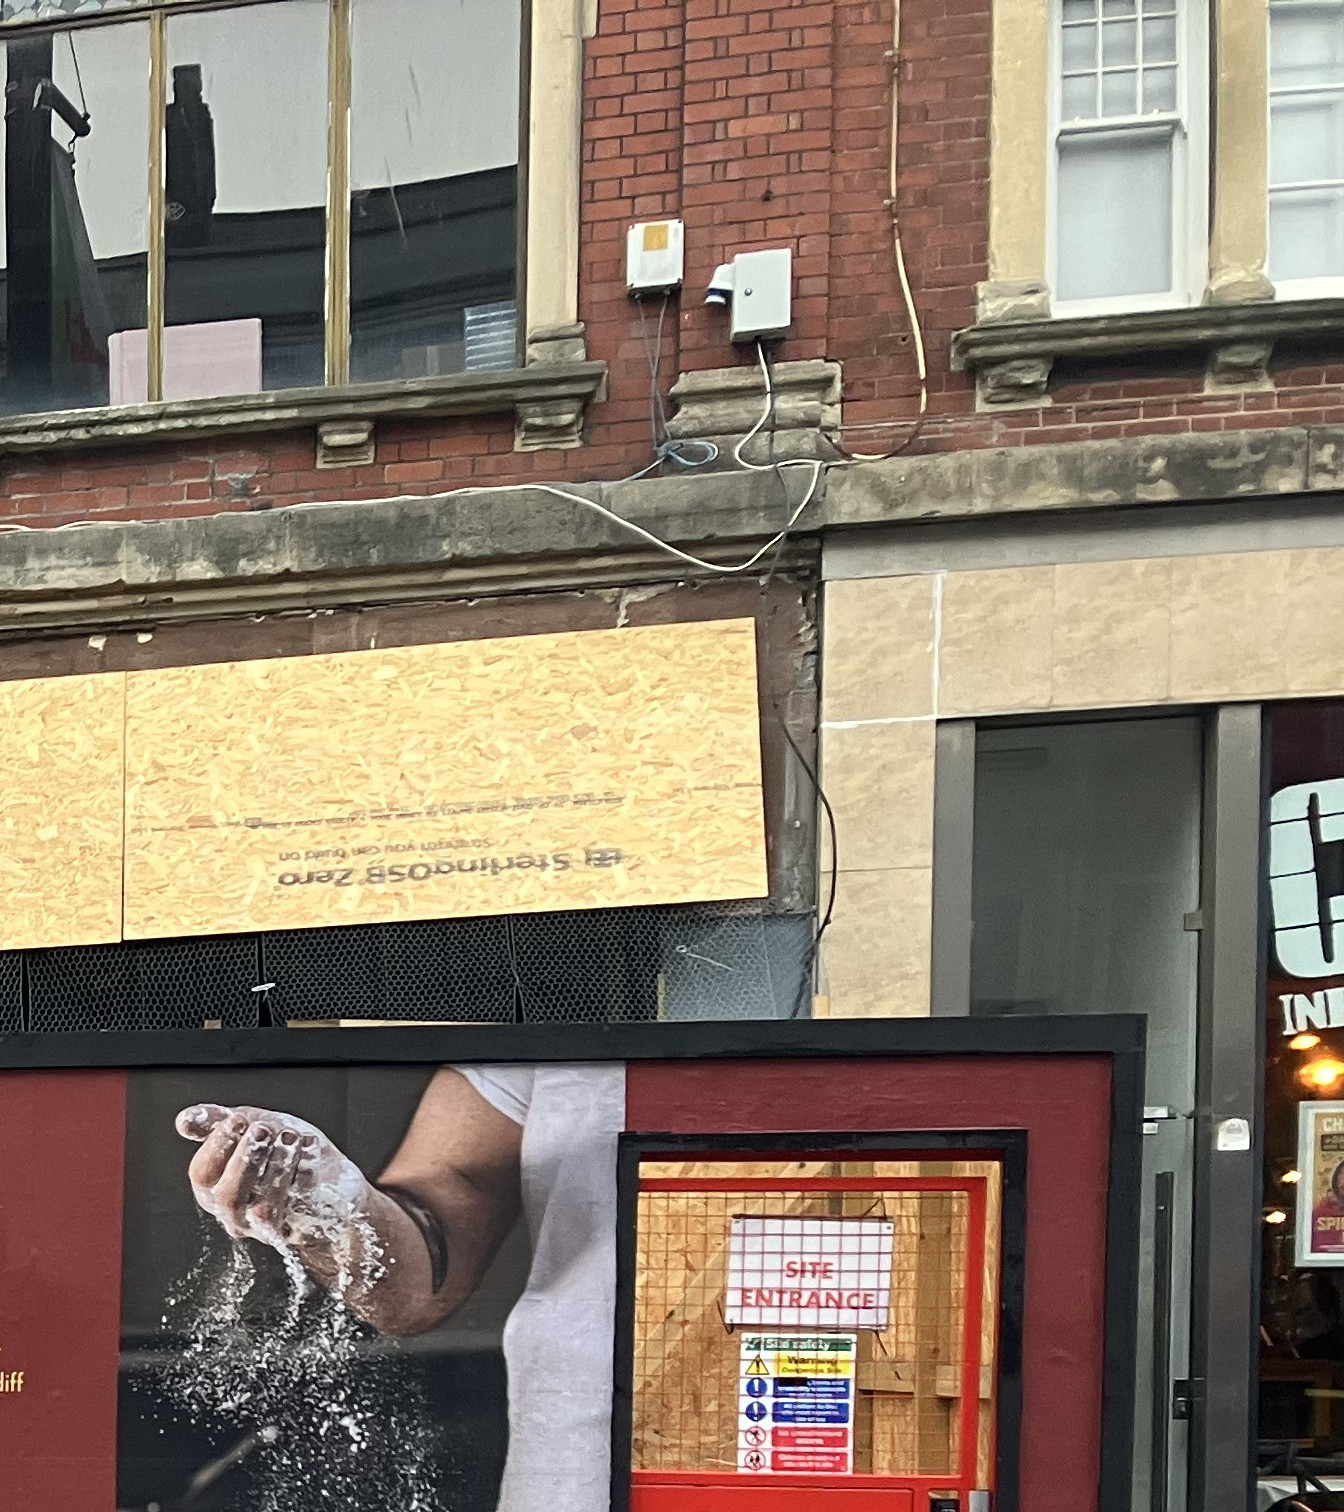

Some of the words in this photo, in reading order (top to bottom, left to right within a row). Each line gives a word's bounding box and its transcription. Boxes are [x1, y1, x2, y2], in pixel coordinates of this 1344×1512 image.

[277, 866, 355, 888] Zero
[785, 1260, 834, 1280] SITE
[741, 1287, 875, 1310] ENTRANCE
